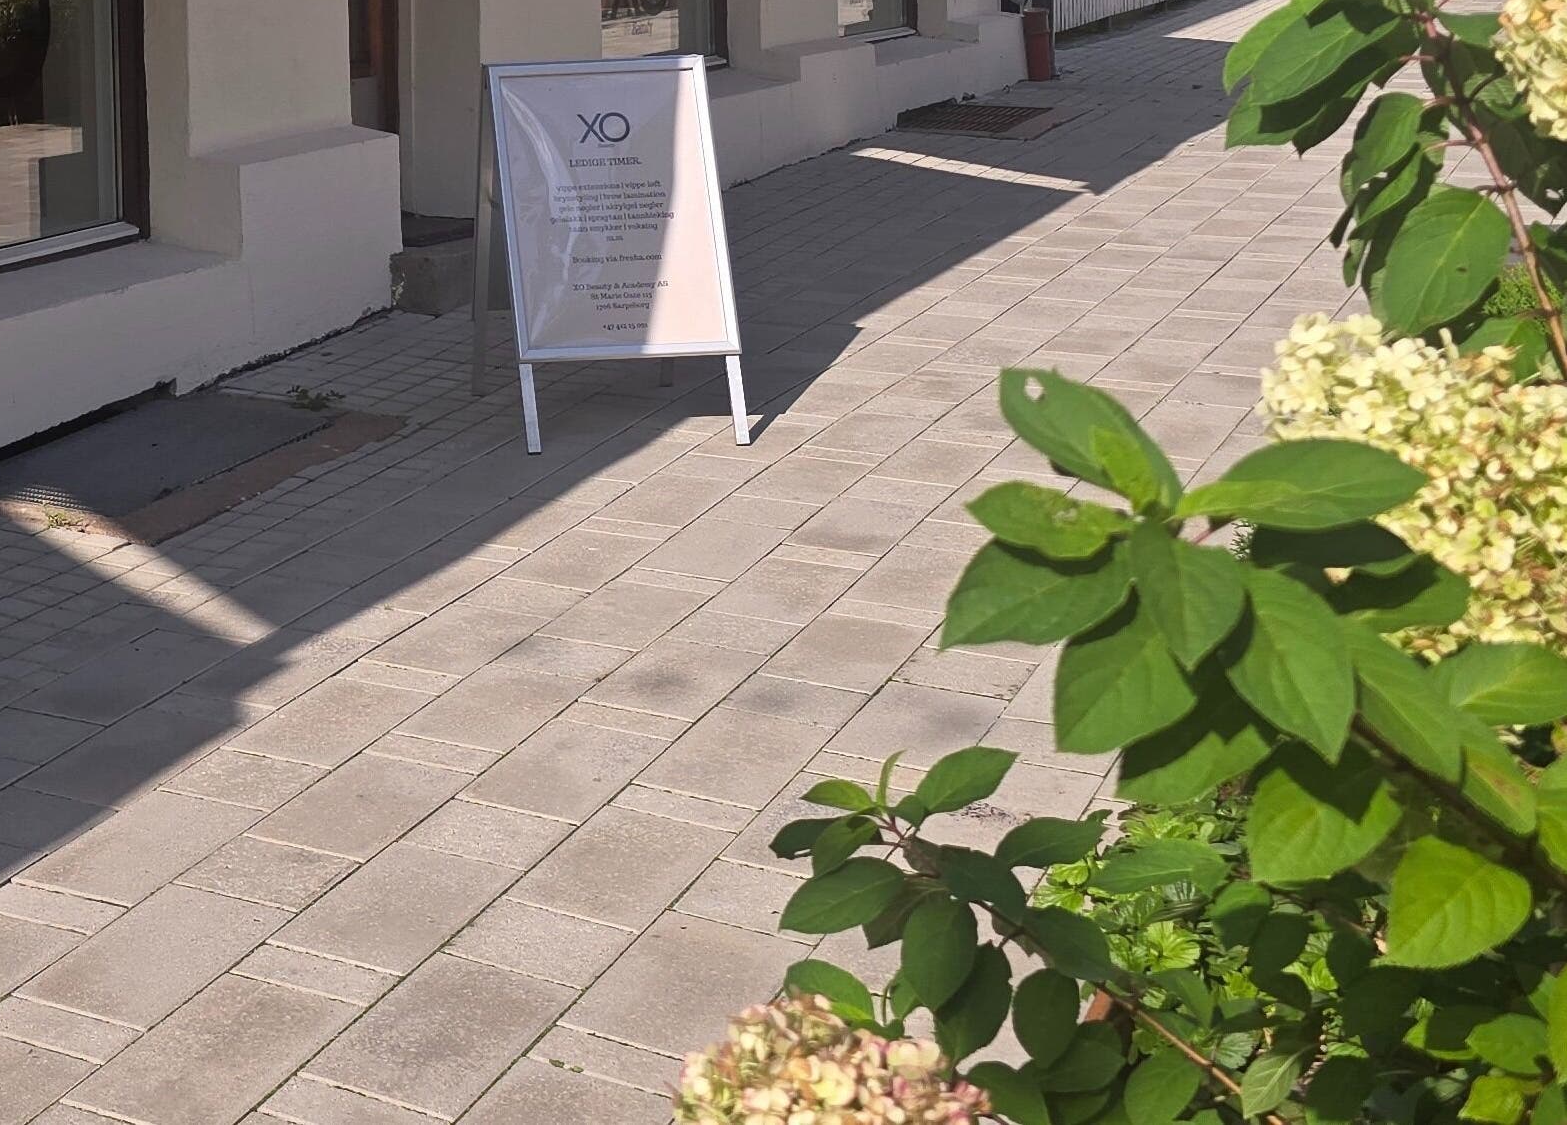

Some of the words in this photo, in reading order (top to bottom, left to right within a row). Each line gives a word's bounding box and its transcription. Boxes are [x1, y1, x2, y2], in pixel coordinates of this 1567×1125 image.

[576, 111, 631, 144] XO
[569, 158, 606, 168] LEDIGE
[572, 283, 585, 291] XO
[622, 281, 655, 289] Academy
